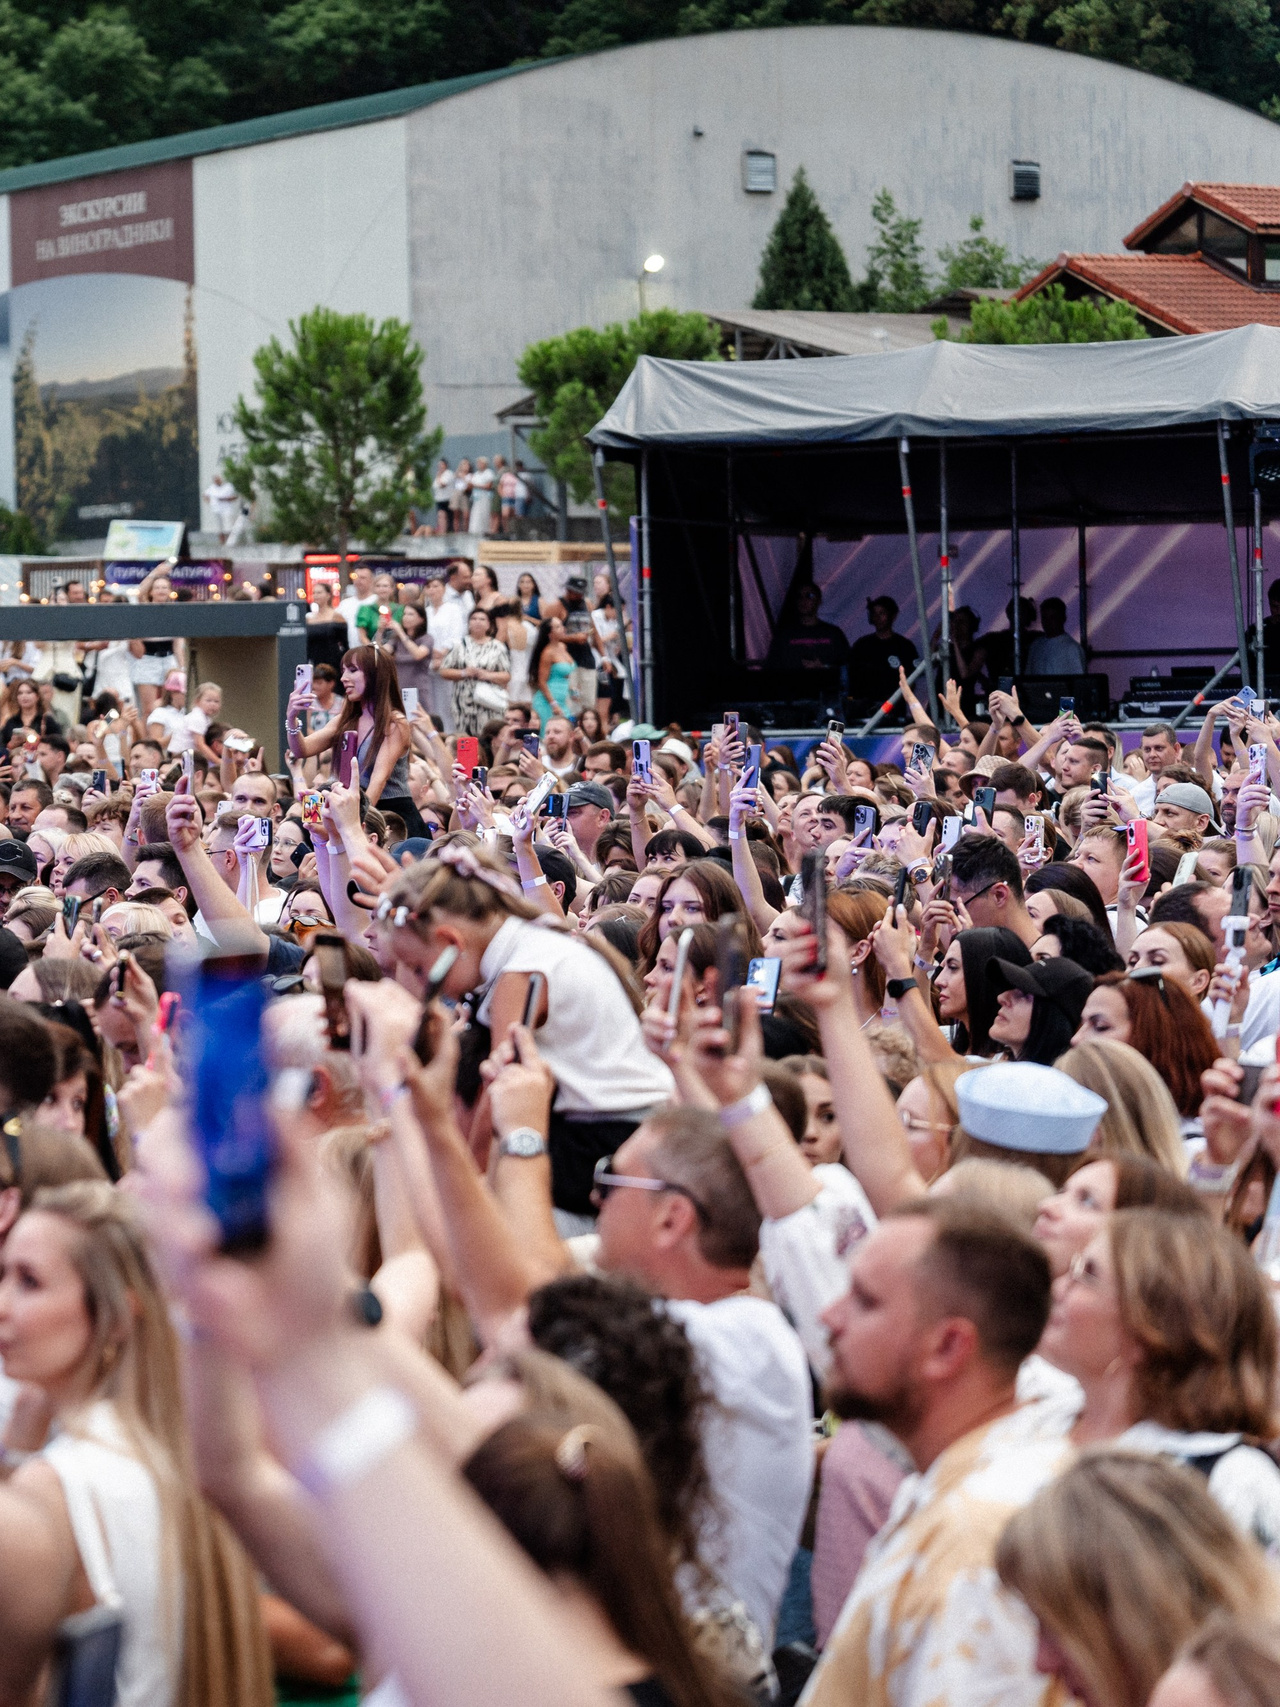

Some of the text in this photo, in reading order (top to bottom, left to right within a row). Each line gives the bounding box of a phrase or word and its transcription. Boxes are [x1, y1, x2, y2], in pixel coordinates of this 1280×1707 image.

[59, 191, 146, 227] ЭКСКУРСИИ
[36, 217, 174, 261] НА ВИНОГРАДНИКИ
